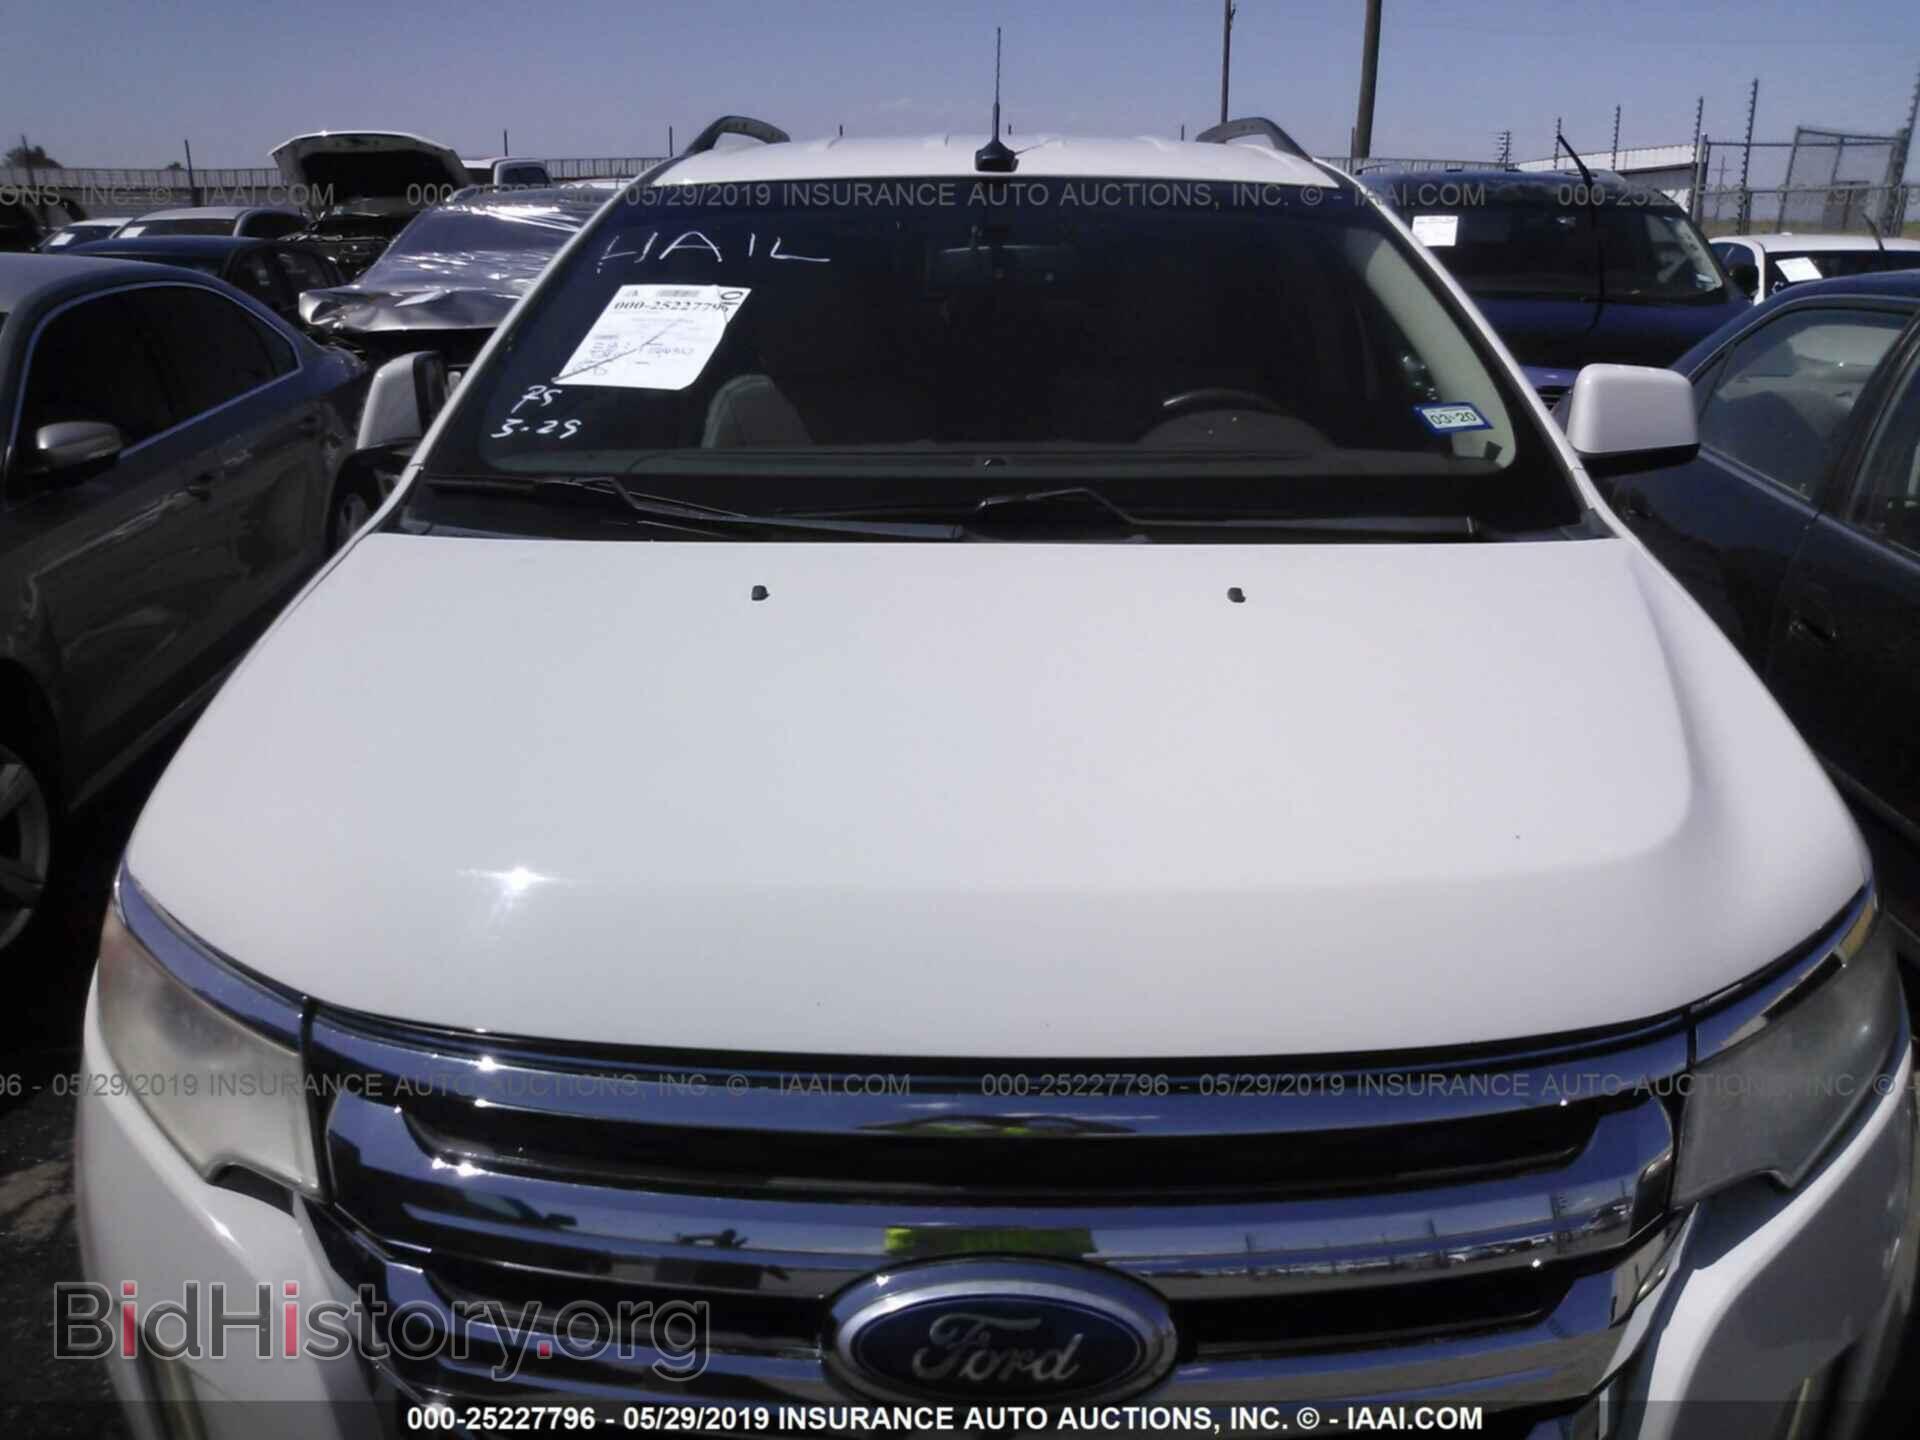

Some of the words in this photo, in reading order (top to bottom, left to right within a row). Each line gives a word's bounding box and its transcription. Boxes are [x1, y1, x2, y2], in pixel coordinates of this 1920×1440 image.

[597, 231, 831, 274] HAIL
[614, 300, 729, 313] 000-25227796
[911, 1313, 1083, 1381] Ford
